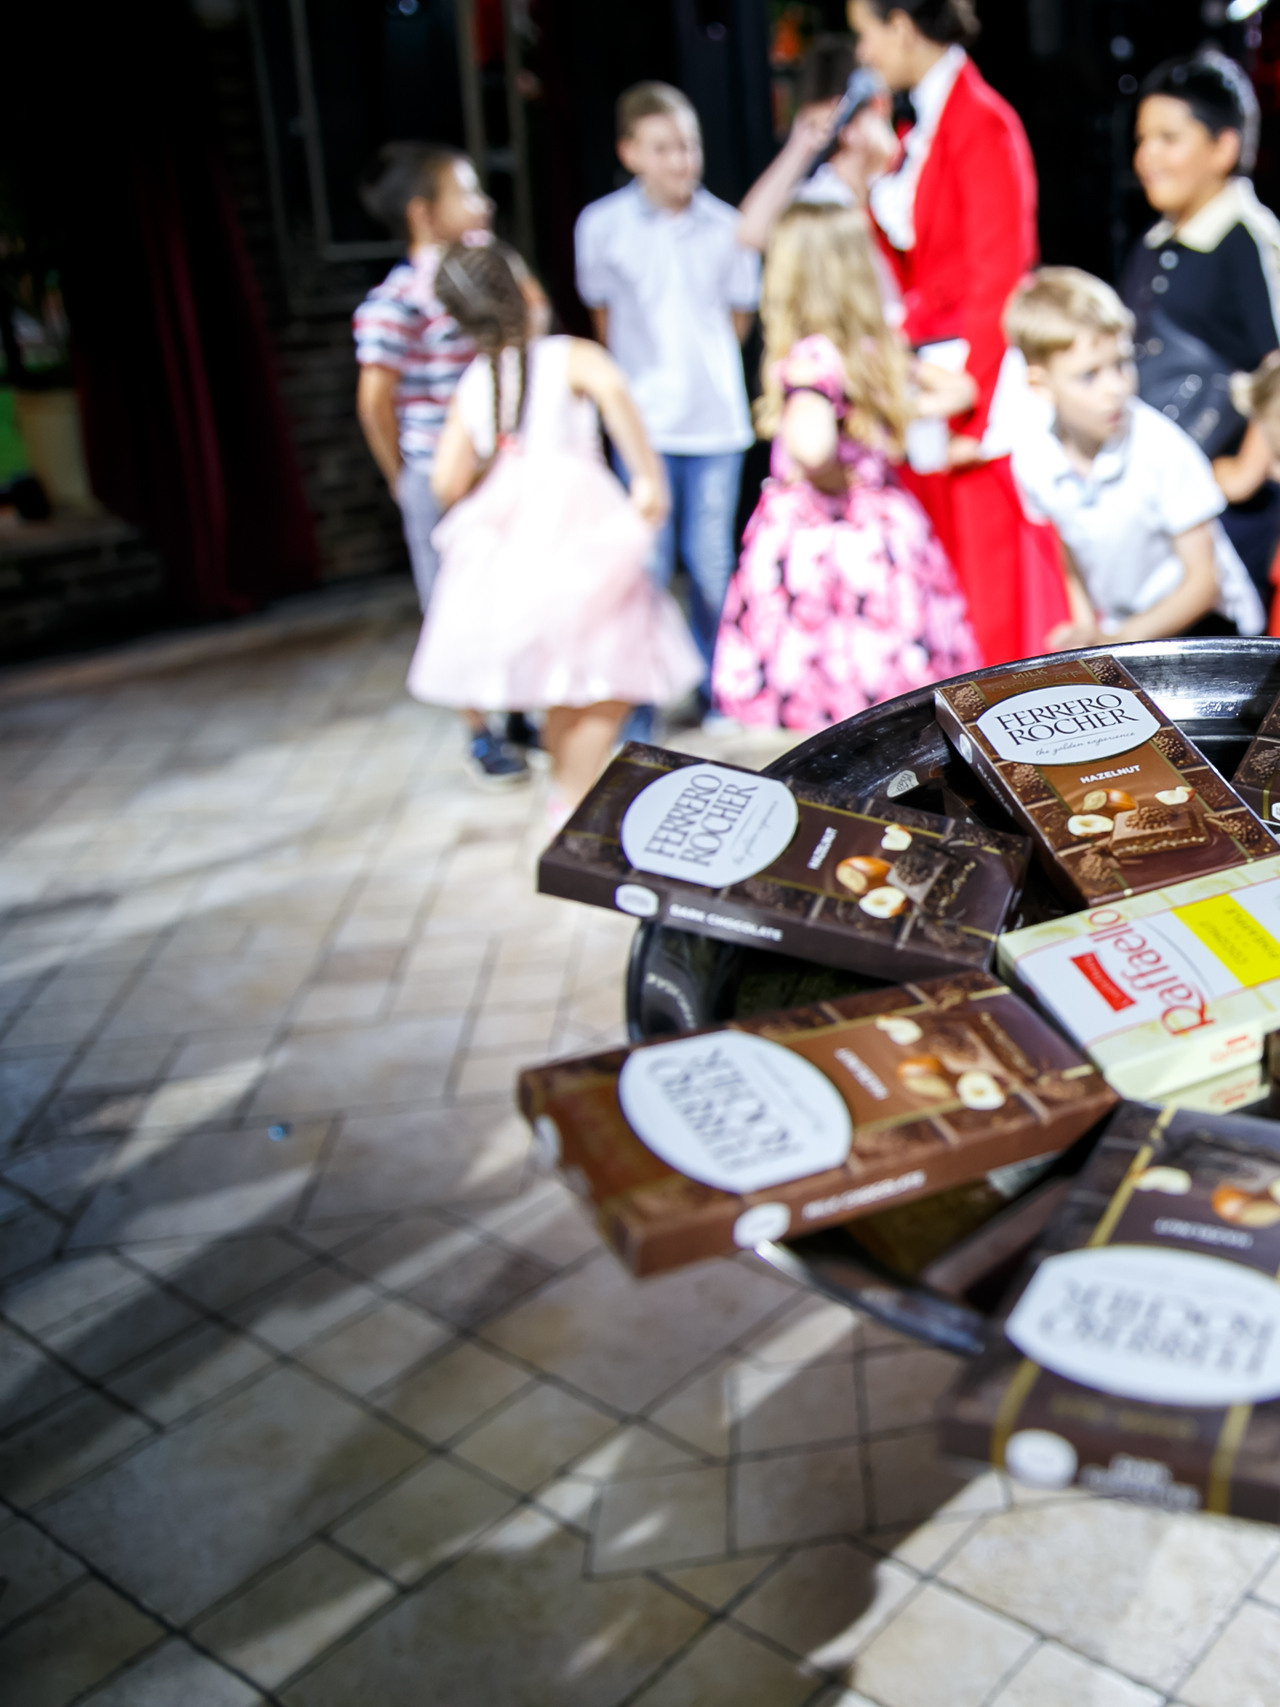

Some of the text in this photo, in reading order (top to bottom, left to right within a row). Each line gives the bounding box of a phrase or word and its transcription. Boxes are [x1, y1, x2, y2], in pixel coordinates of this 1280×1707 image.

[1011, 668, 1048, 680] MILK
[995, 693, 1123, 730] FERRERO
[1007, 708, 1140, 746] ROCHER
[1079, 764, 1142, 784] HAZELNUT
[643, 773, 722, 858] FERRERO
[679, 783, 759, 867] ROCHER
[1088, 908, 1216, 1037] Raffaello
